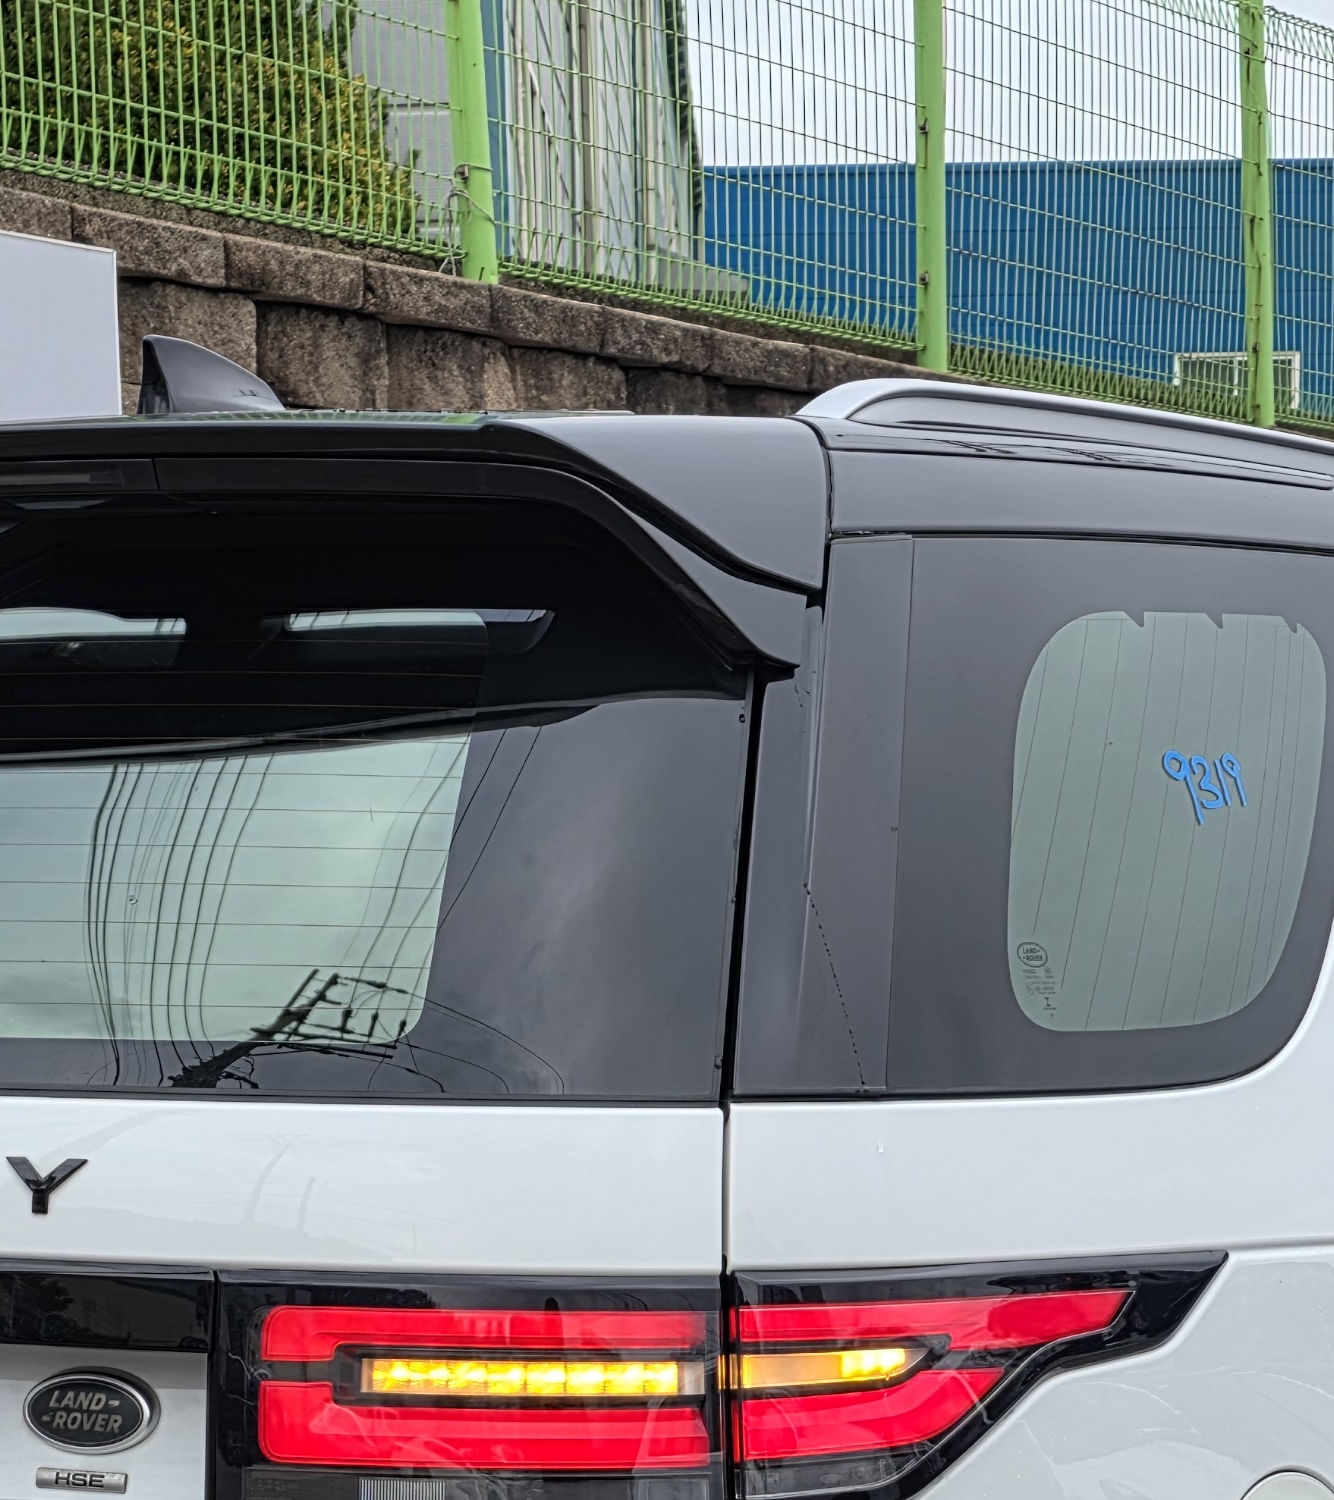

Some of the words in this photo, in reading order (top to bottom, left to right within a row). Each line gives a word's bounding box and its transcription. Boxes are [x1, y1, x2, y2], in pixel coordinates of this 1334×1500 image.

[1161, 749, 1247, 826] 9319
[49, 1389, 107, 1411] LAND
[52, 1410, 123, 1433] ROVER
[54, 1471, 106, 1488] HSE
